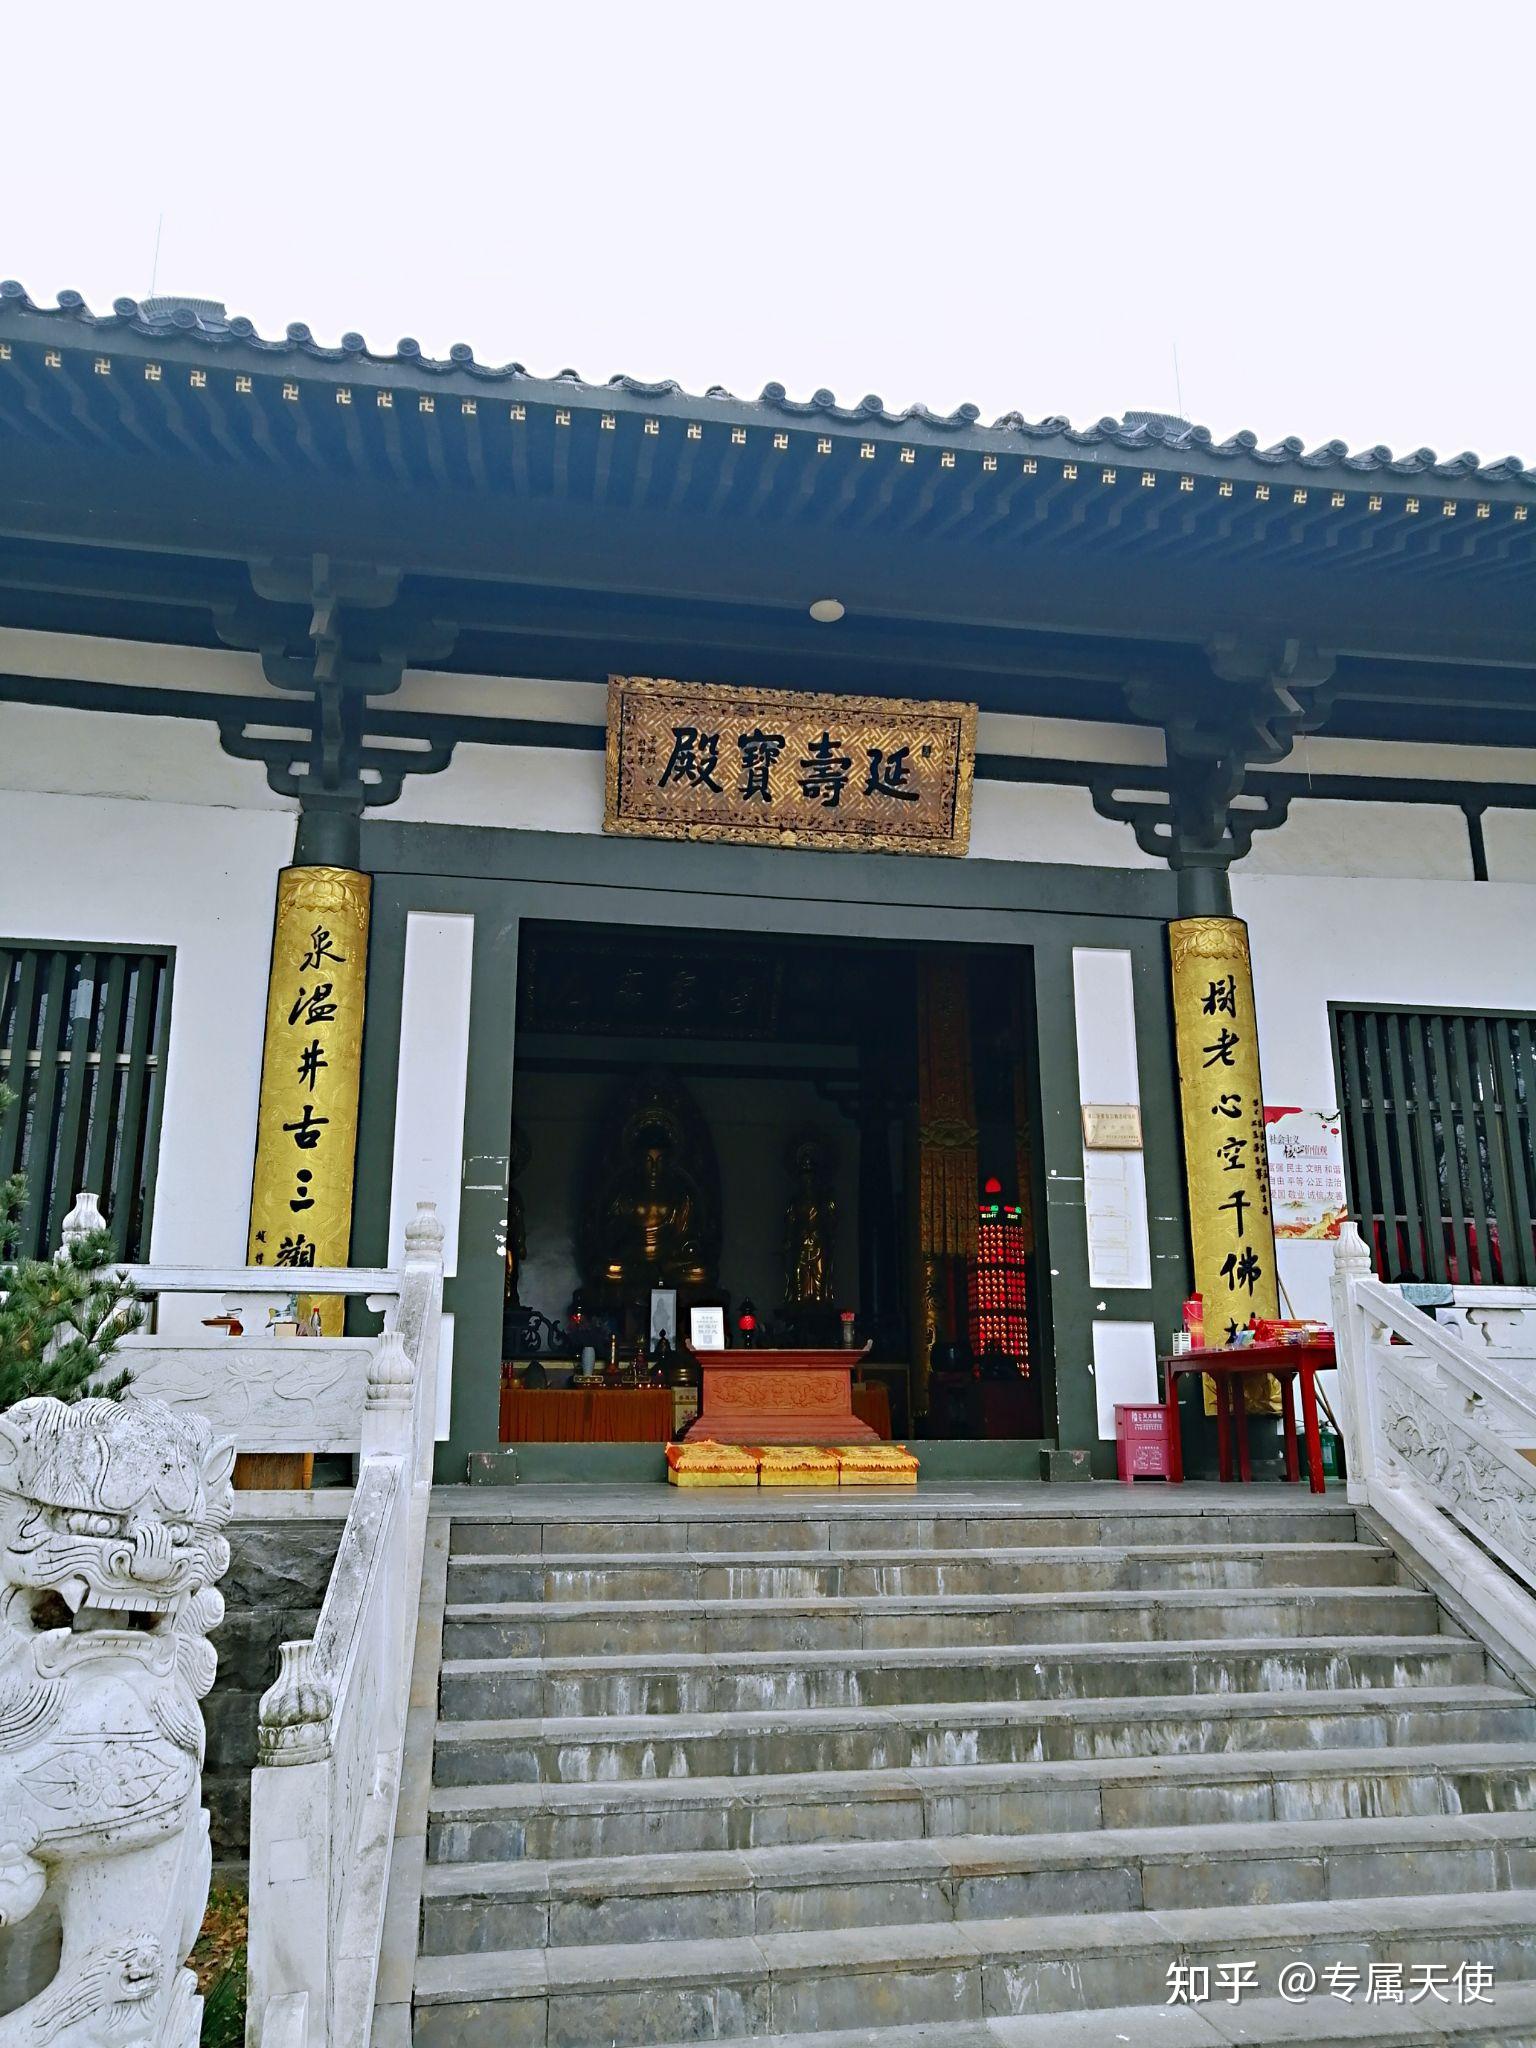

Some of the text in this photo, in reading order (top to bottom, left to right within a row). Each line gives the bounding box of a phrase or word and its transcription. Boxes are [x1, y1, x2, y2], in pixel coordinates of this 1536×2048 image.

[658, 727, 920, 808] 延壽寶殿
[1286, 1162, 1303, 1173] 民主
[1305, 1163, 1322, 1174] 文明
[1269, 1176, 1285, 1186] 自由
[1287, 1176, 1304, 1187] 平等
[1306, 1177, 1323, 1187] 公正
